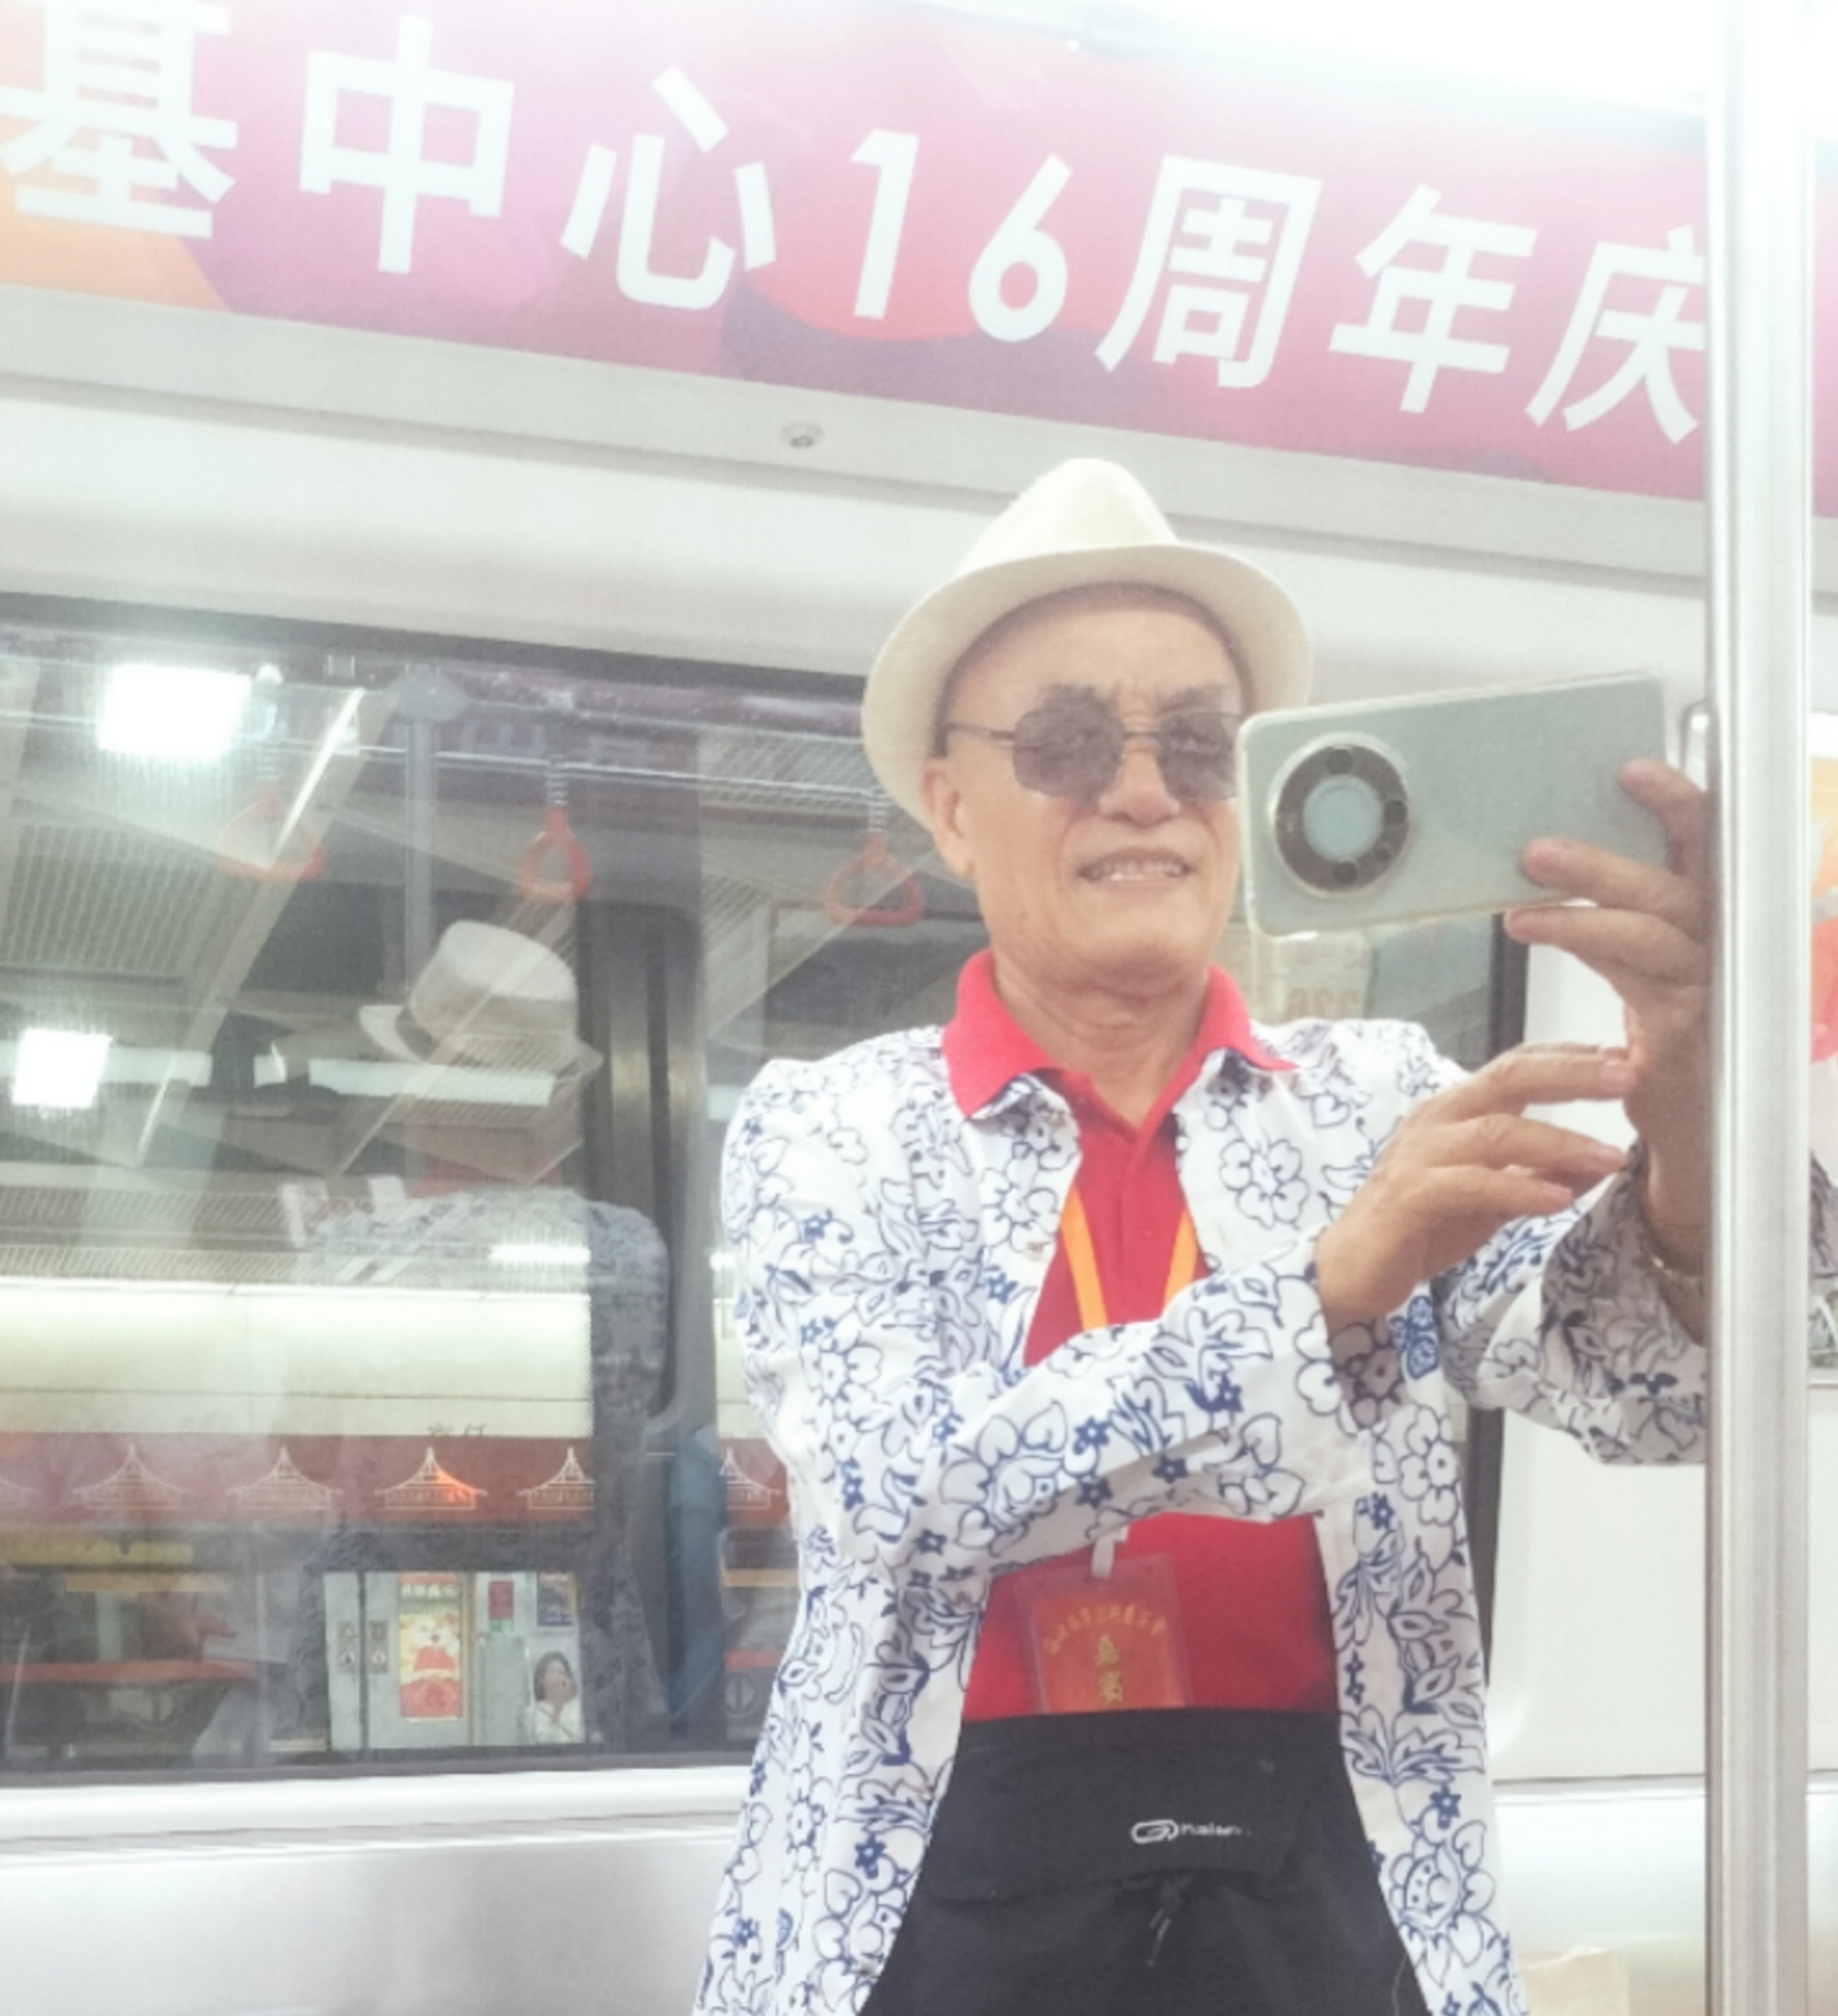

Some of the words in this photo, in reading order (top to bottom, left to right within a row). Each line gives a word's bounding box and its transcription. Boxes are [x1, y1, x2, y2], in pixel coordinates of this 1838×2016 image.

[0, 0, 1706, 444] 基中心16周年庆
